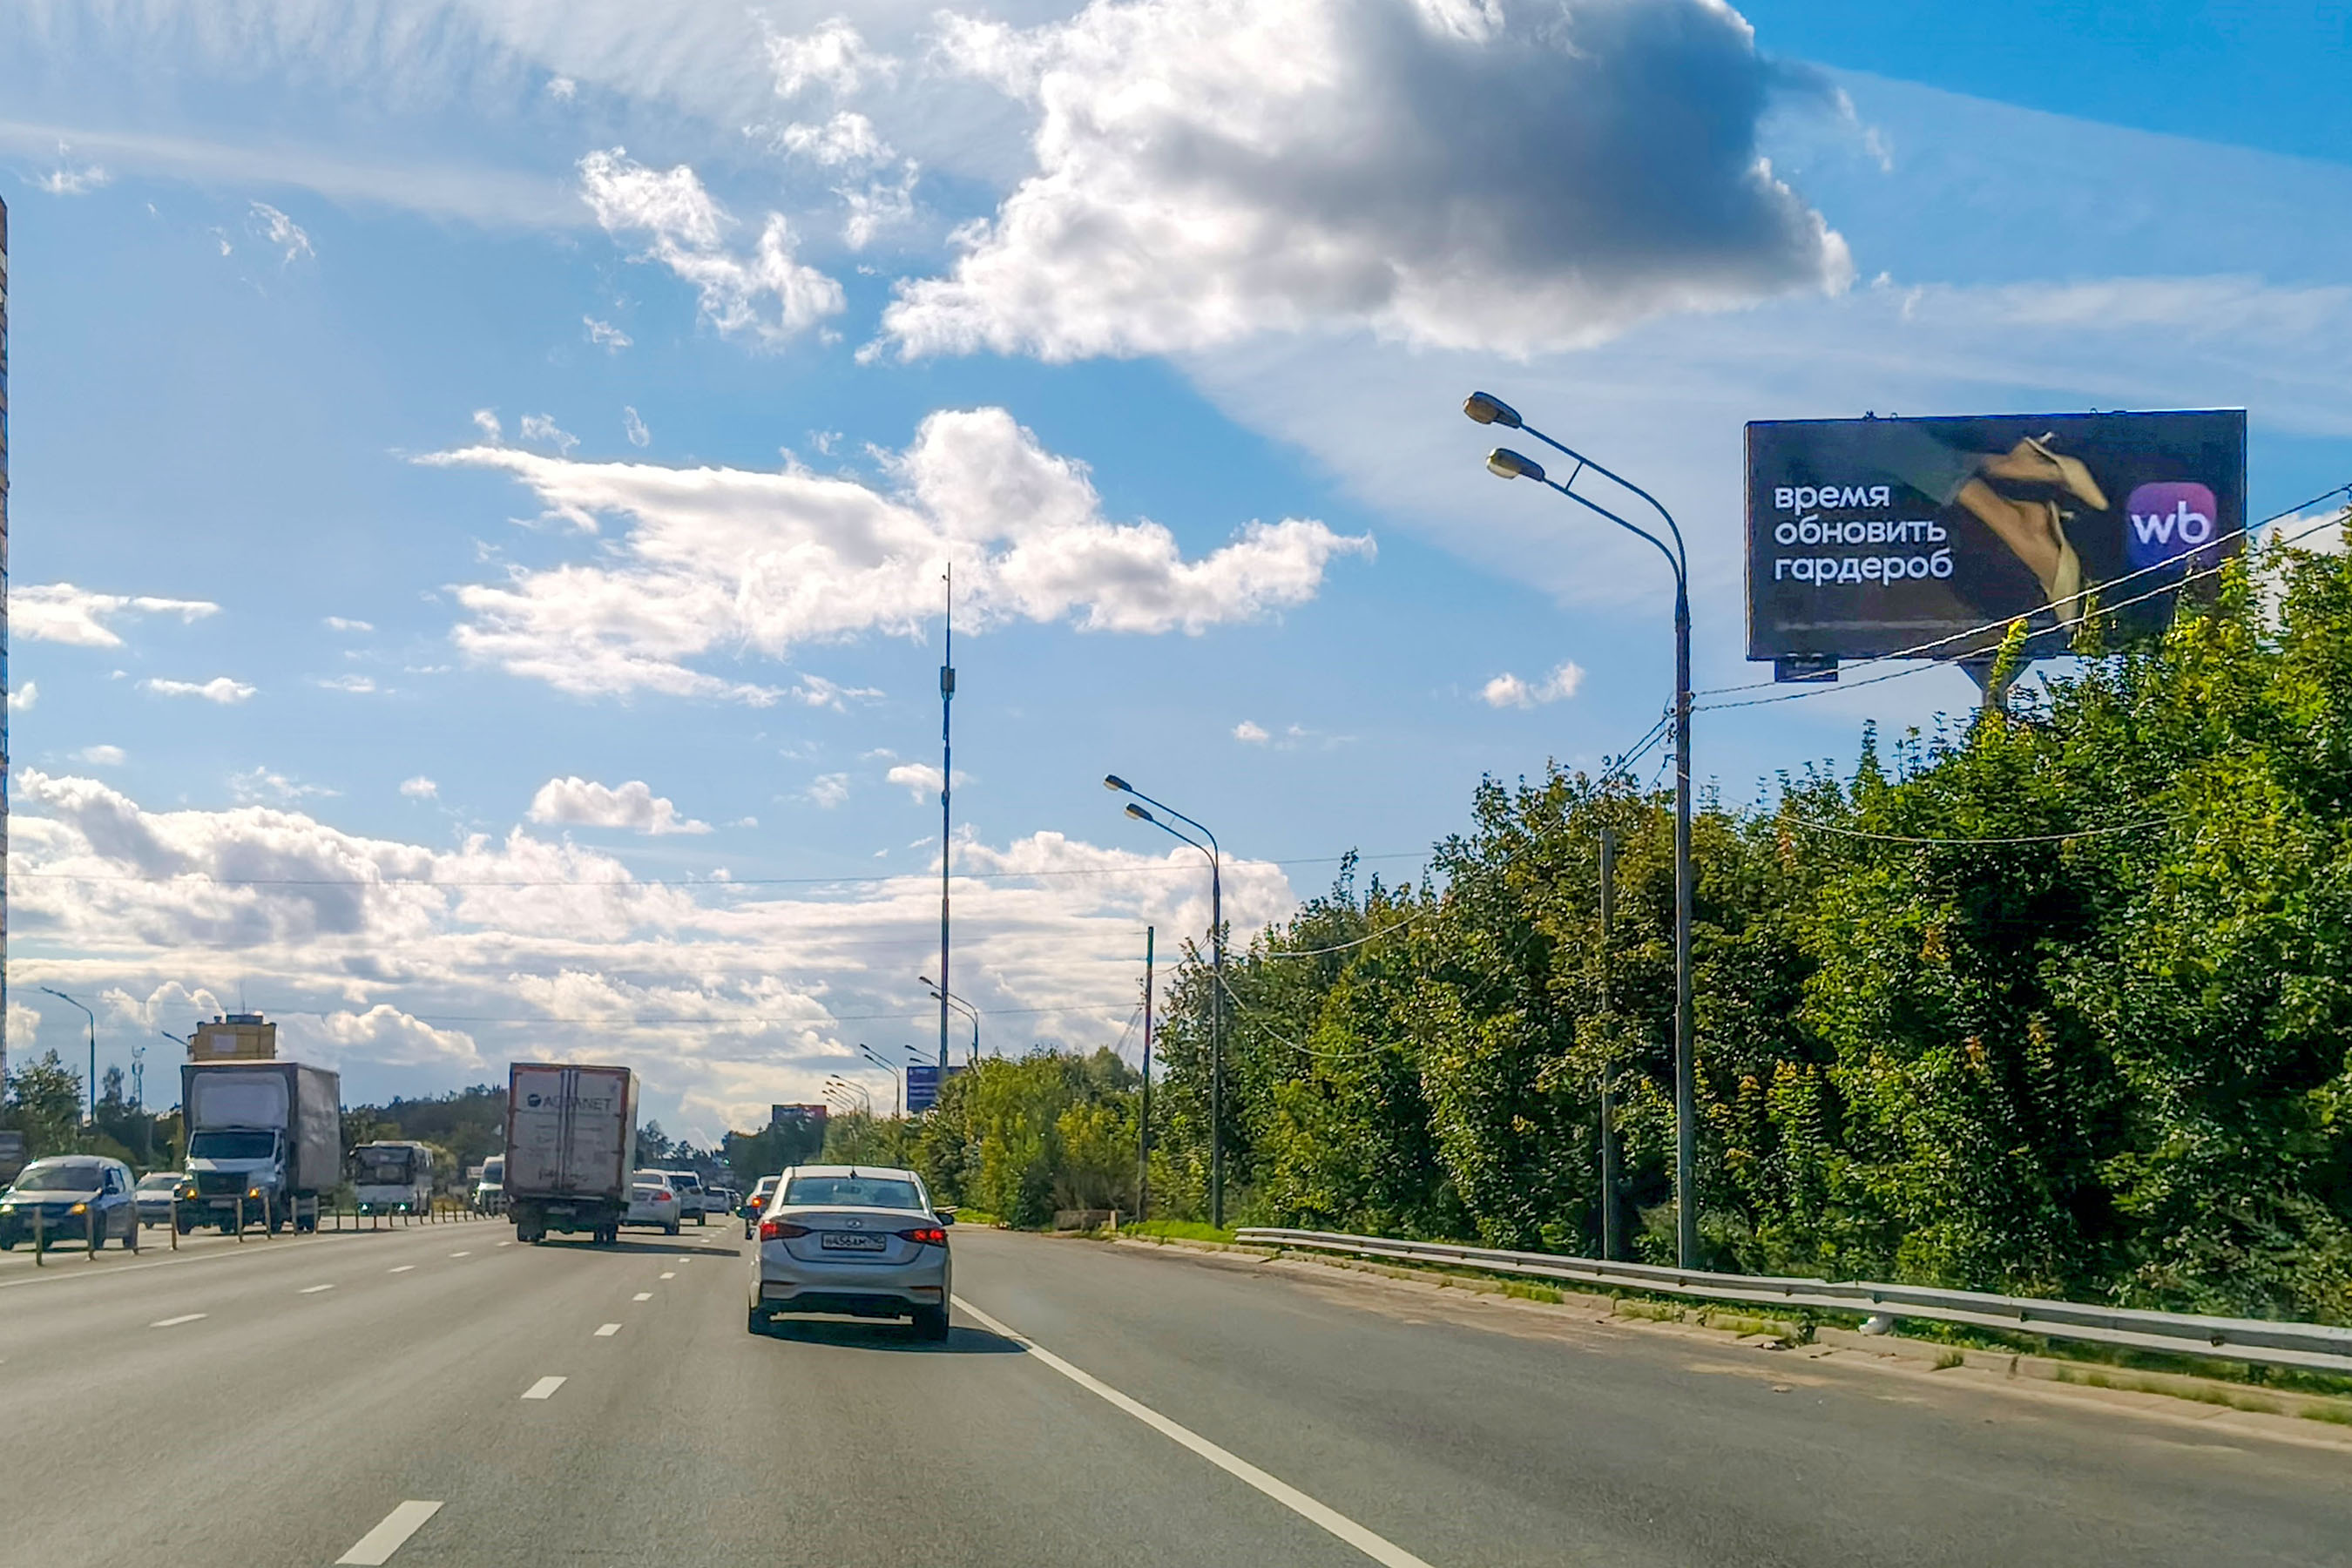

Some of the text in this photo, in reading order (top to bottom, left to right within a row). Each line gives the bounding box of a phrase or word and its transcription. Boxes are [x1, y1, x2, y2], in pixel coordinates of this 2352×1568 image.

[1774, 485, 1890, 516] время
[1774, 513, 1947, 544] обновить
[2131, 500, 2211, 544] wb
[1774, 547, 1953, 587] гардероб
